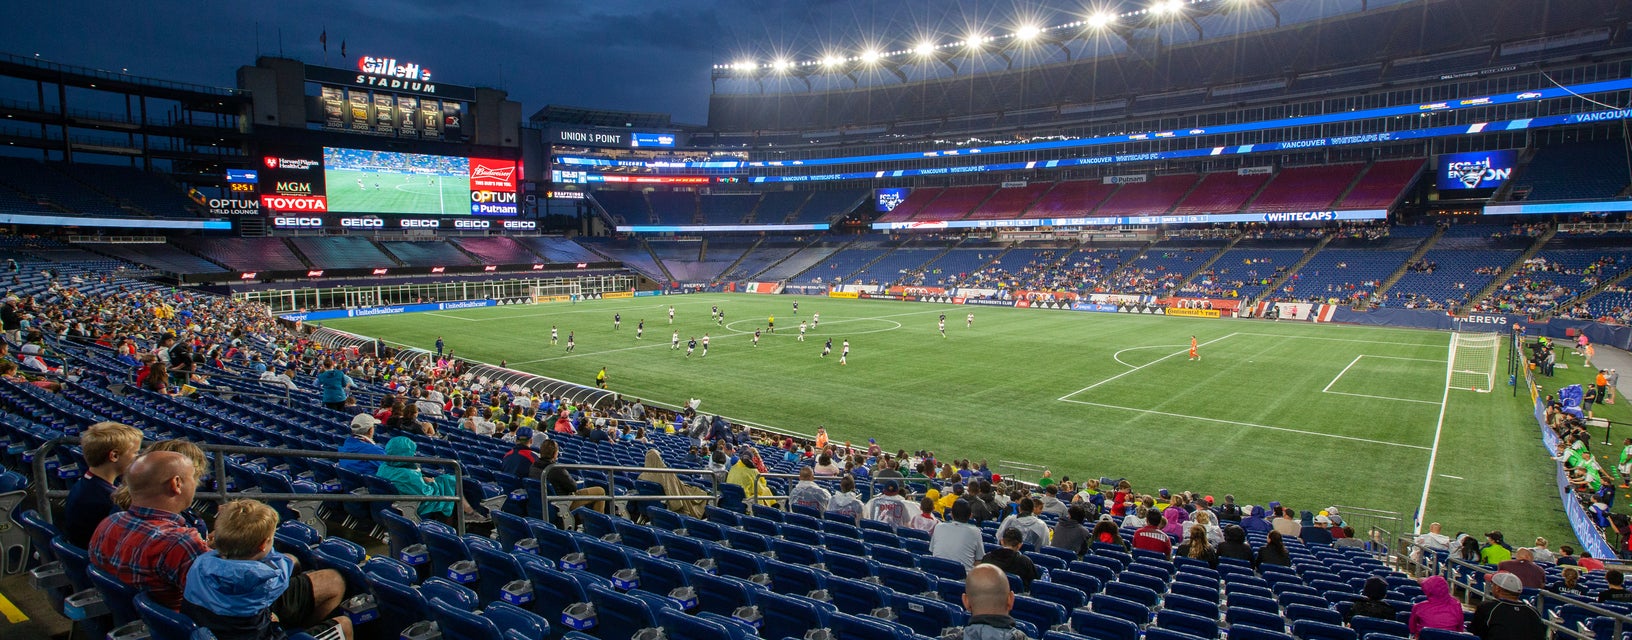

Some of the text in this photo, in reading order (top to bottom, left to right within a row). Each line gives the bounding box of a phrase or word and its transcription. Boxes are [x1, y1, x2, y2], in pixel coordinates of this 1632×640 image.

[358, 55, 431, 81] Gillette
[356, 75, 435, 93] STADIUM
[1576, 109, 1632, 122] VANCOUV
[561, 131, 587, 142] UNION
[595, 134, 621, 144] POINT
[1281, 133, 1390, 149] VANCOUVER WHITECAPS FC
[1080, 156, 1112, 164] VANCOUVER
[475, 167, 512, 177] Budweiser
[276, 181, 311, 192] MGM
[472, 191, 516, 203] OPTUM
[209, 199, 259, 209] OPTUM
[264, 198, 326, 210] TOYOTA
[480, 204, 517, 214] Putnam
[274, 217, 322, 226] GEICO
[1268, 211, 1332, 222] WHITECAPS
[340, 218, 384, 227] GEICO
[401, 219, 439, 228] GEICO
[454, 220, 490, 228] GEICO
[445, 301, 487, 309] UnitedHealthcare
[355, 307, 405, 316] UnitedHealthcare
[1167, 308, 1200, 316] Continental
